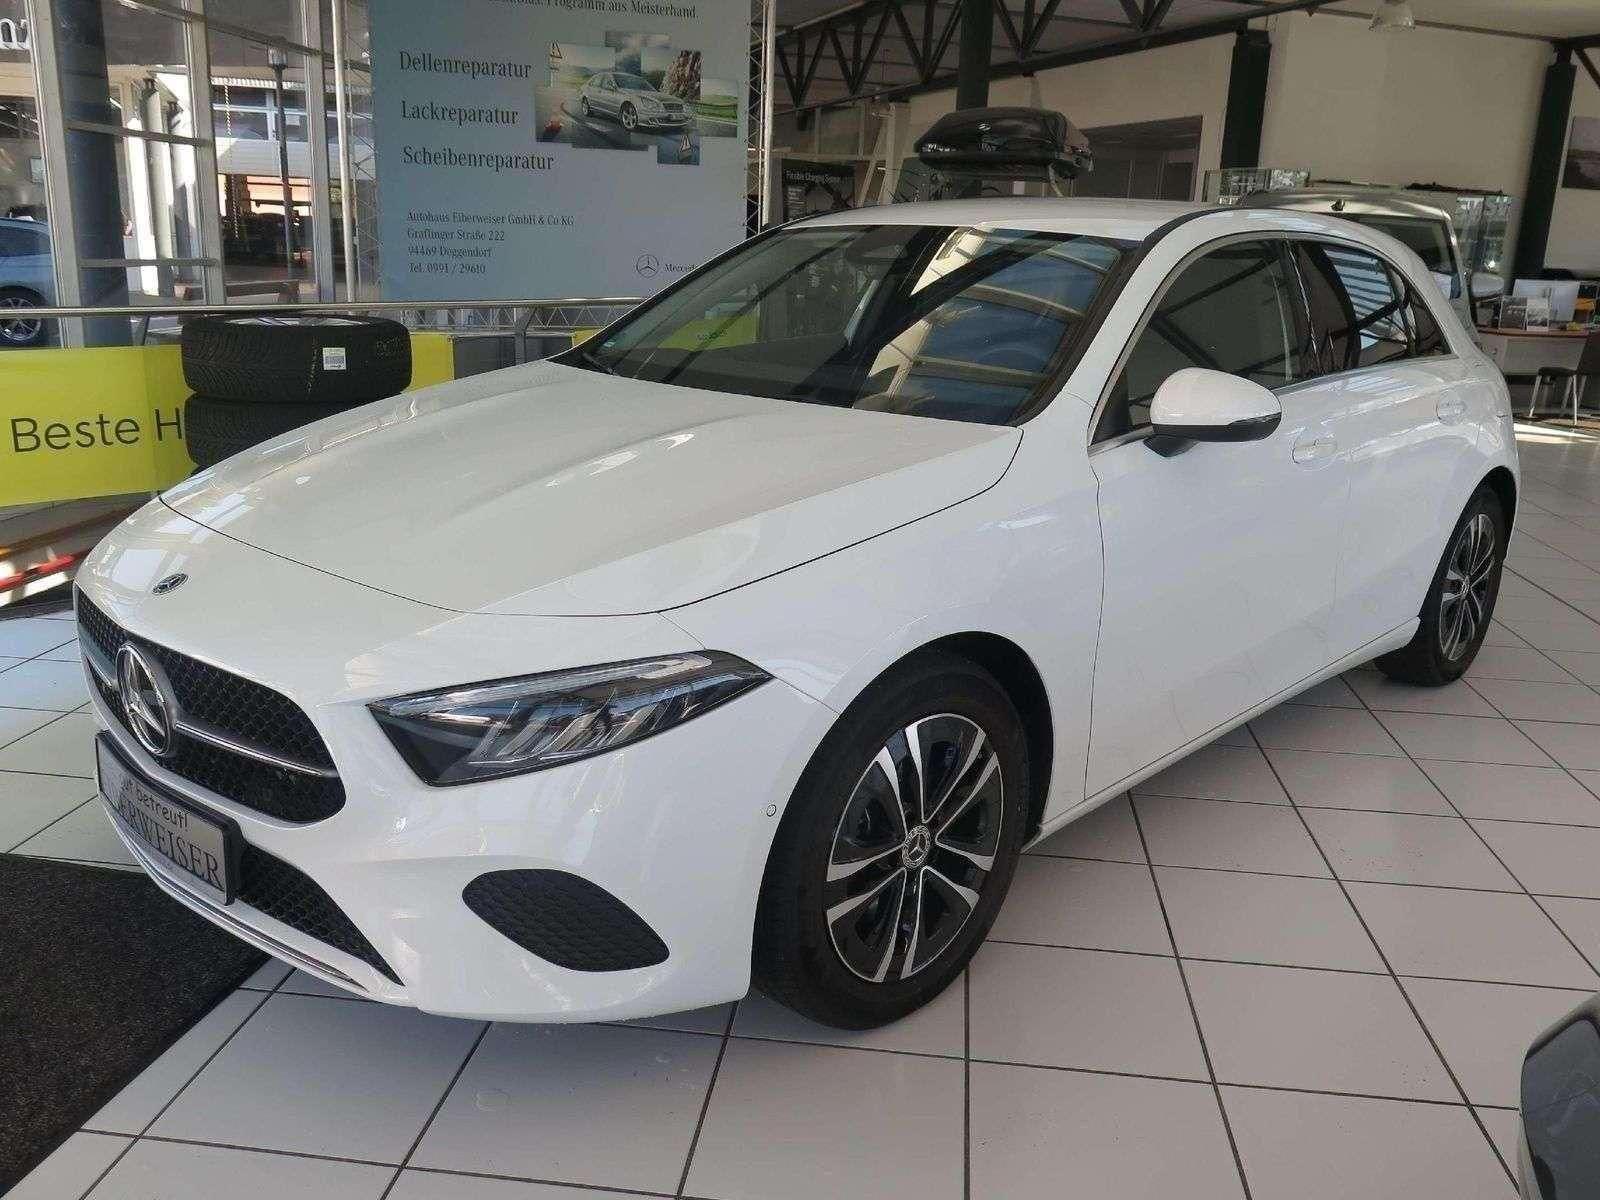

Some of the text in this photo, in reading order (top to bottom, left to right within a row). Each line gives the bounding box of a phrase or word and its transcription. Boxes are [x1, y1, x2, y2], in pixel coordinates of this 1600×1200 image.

[609, 2, 628, 12] aus
[400, 51, 532, 79] Dellenreparatur
[401, 100, 519, 126] Lackreparatur
[403, 146, 555, 172] Scheibenreparatur
[408, 211, 449, 223] Autohaus
[508, 214, 536, 225] GmbH
[488, 230, 505, 241] 222
[11, 407, 183, 453] Beste H
